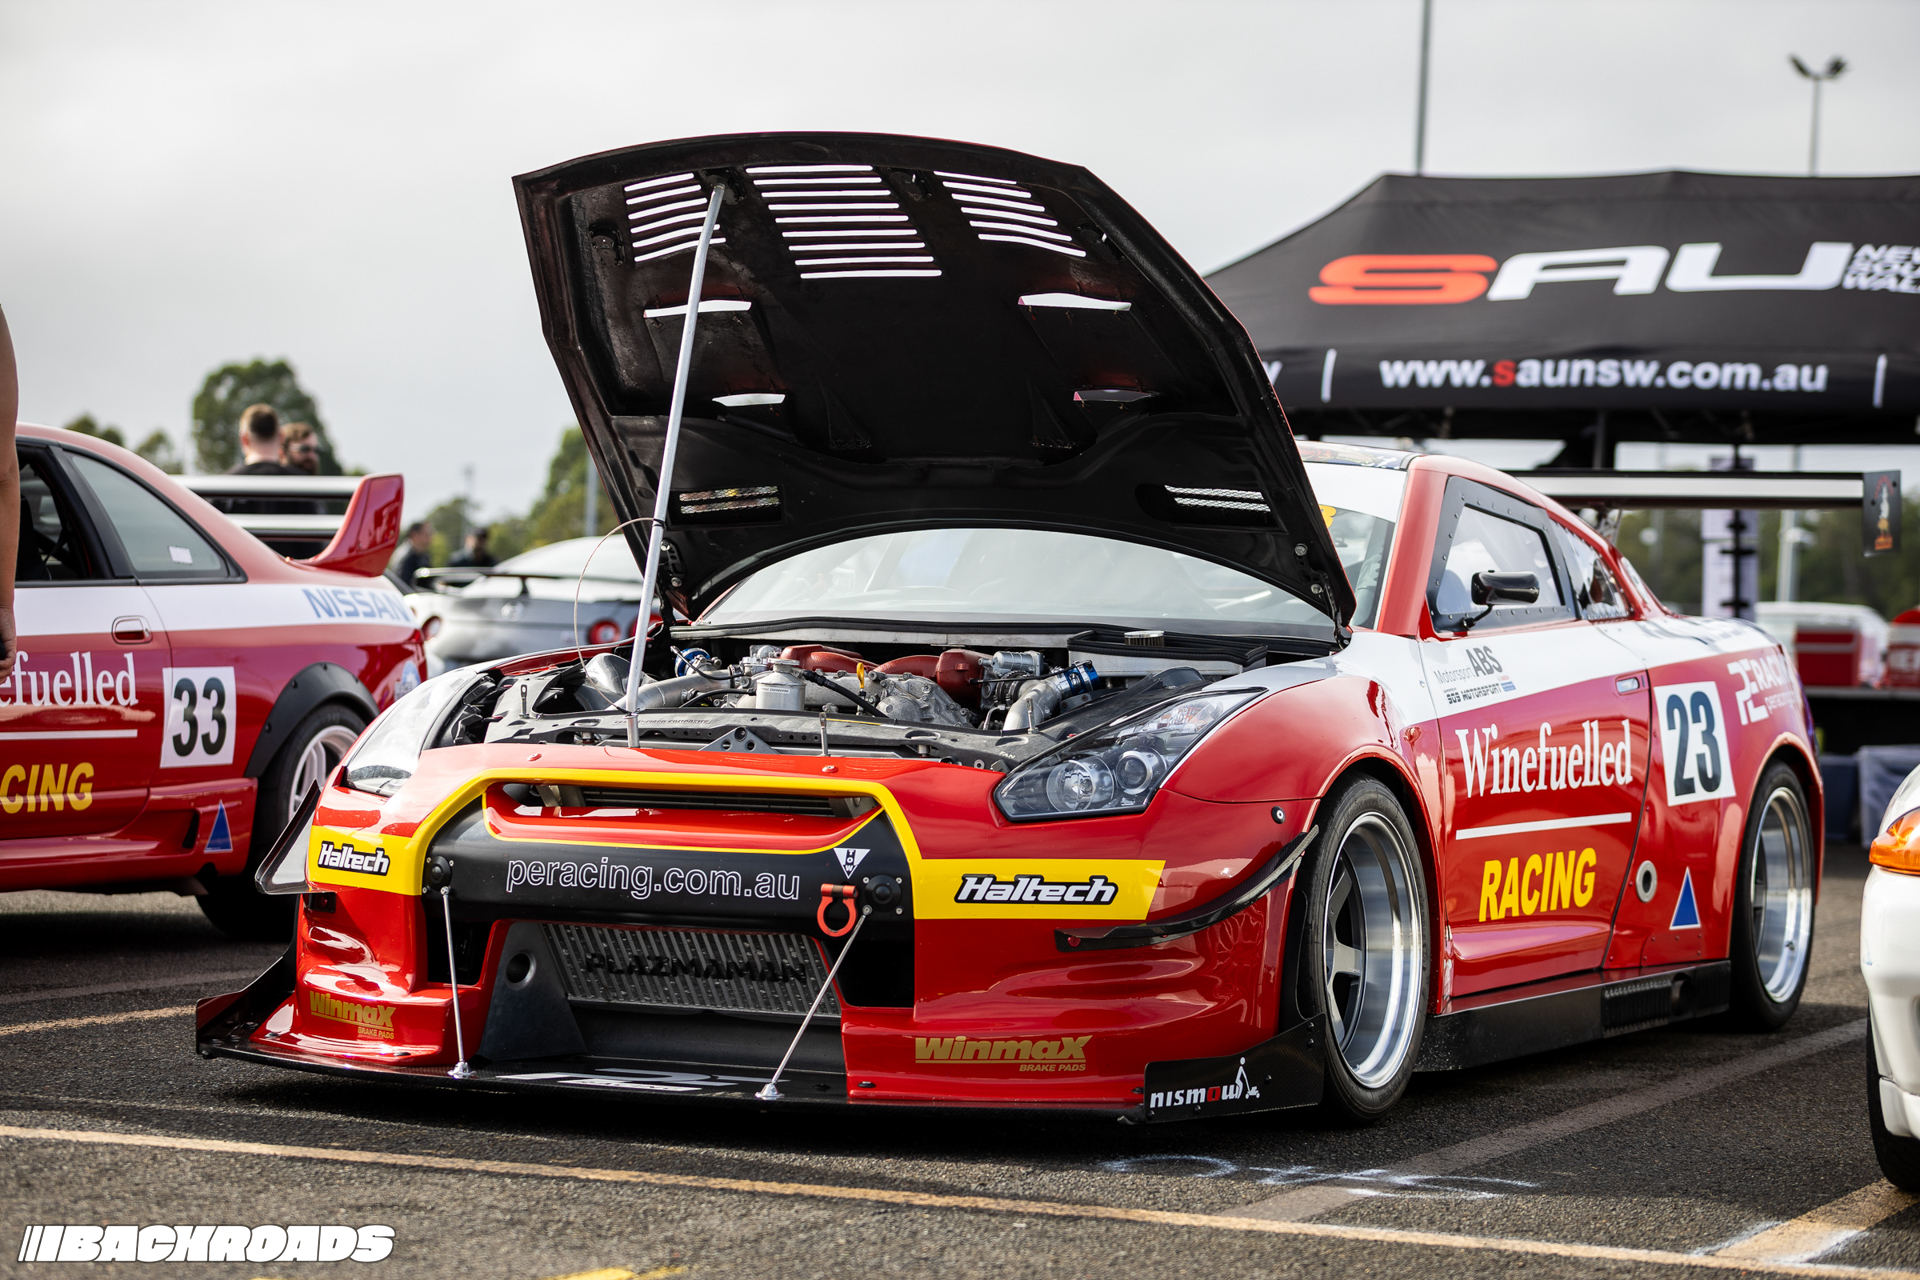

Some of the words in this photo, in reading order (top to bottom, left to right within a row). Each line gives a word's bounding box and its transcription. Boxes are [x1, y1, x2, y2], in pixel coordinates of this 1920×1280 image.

[1308, 241, 1854, 305] SAU
[1379, 356, 1828, 392] www.saunsw.com.au
[302, 587, 410, 624] NISSAN
[1465, 645, 1503, 677] ABS
[172, 677, 227, 757] 33
[1454, 718, 1633, 798] Winefuelled
[1665, 690, 1722, 797] 23
[317, 841, 391, 876] Haltech
[846, 848, 856, 872] TOW
[506, 855, 801, 901] peracing.com.au
[954, 873, 1119, 906] Haltech
[1478, 847, 1597, 922] RACING
[585, 952, 808, 984] PLAZMAMAN
[357, 1026, 378, 1038] BRAKE
[378, 1030, 395, 1040] PADS
[1019, 1064, 1057, 1072] BRAKE
[1058, 1063, 1087, 1072] PADS
